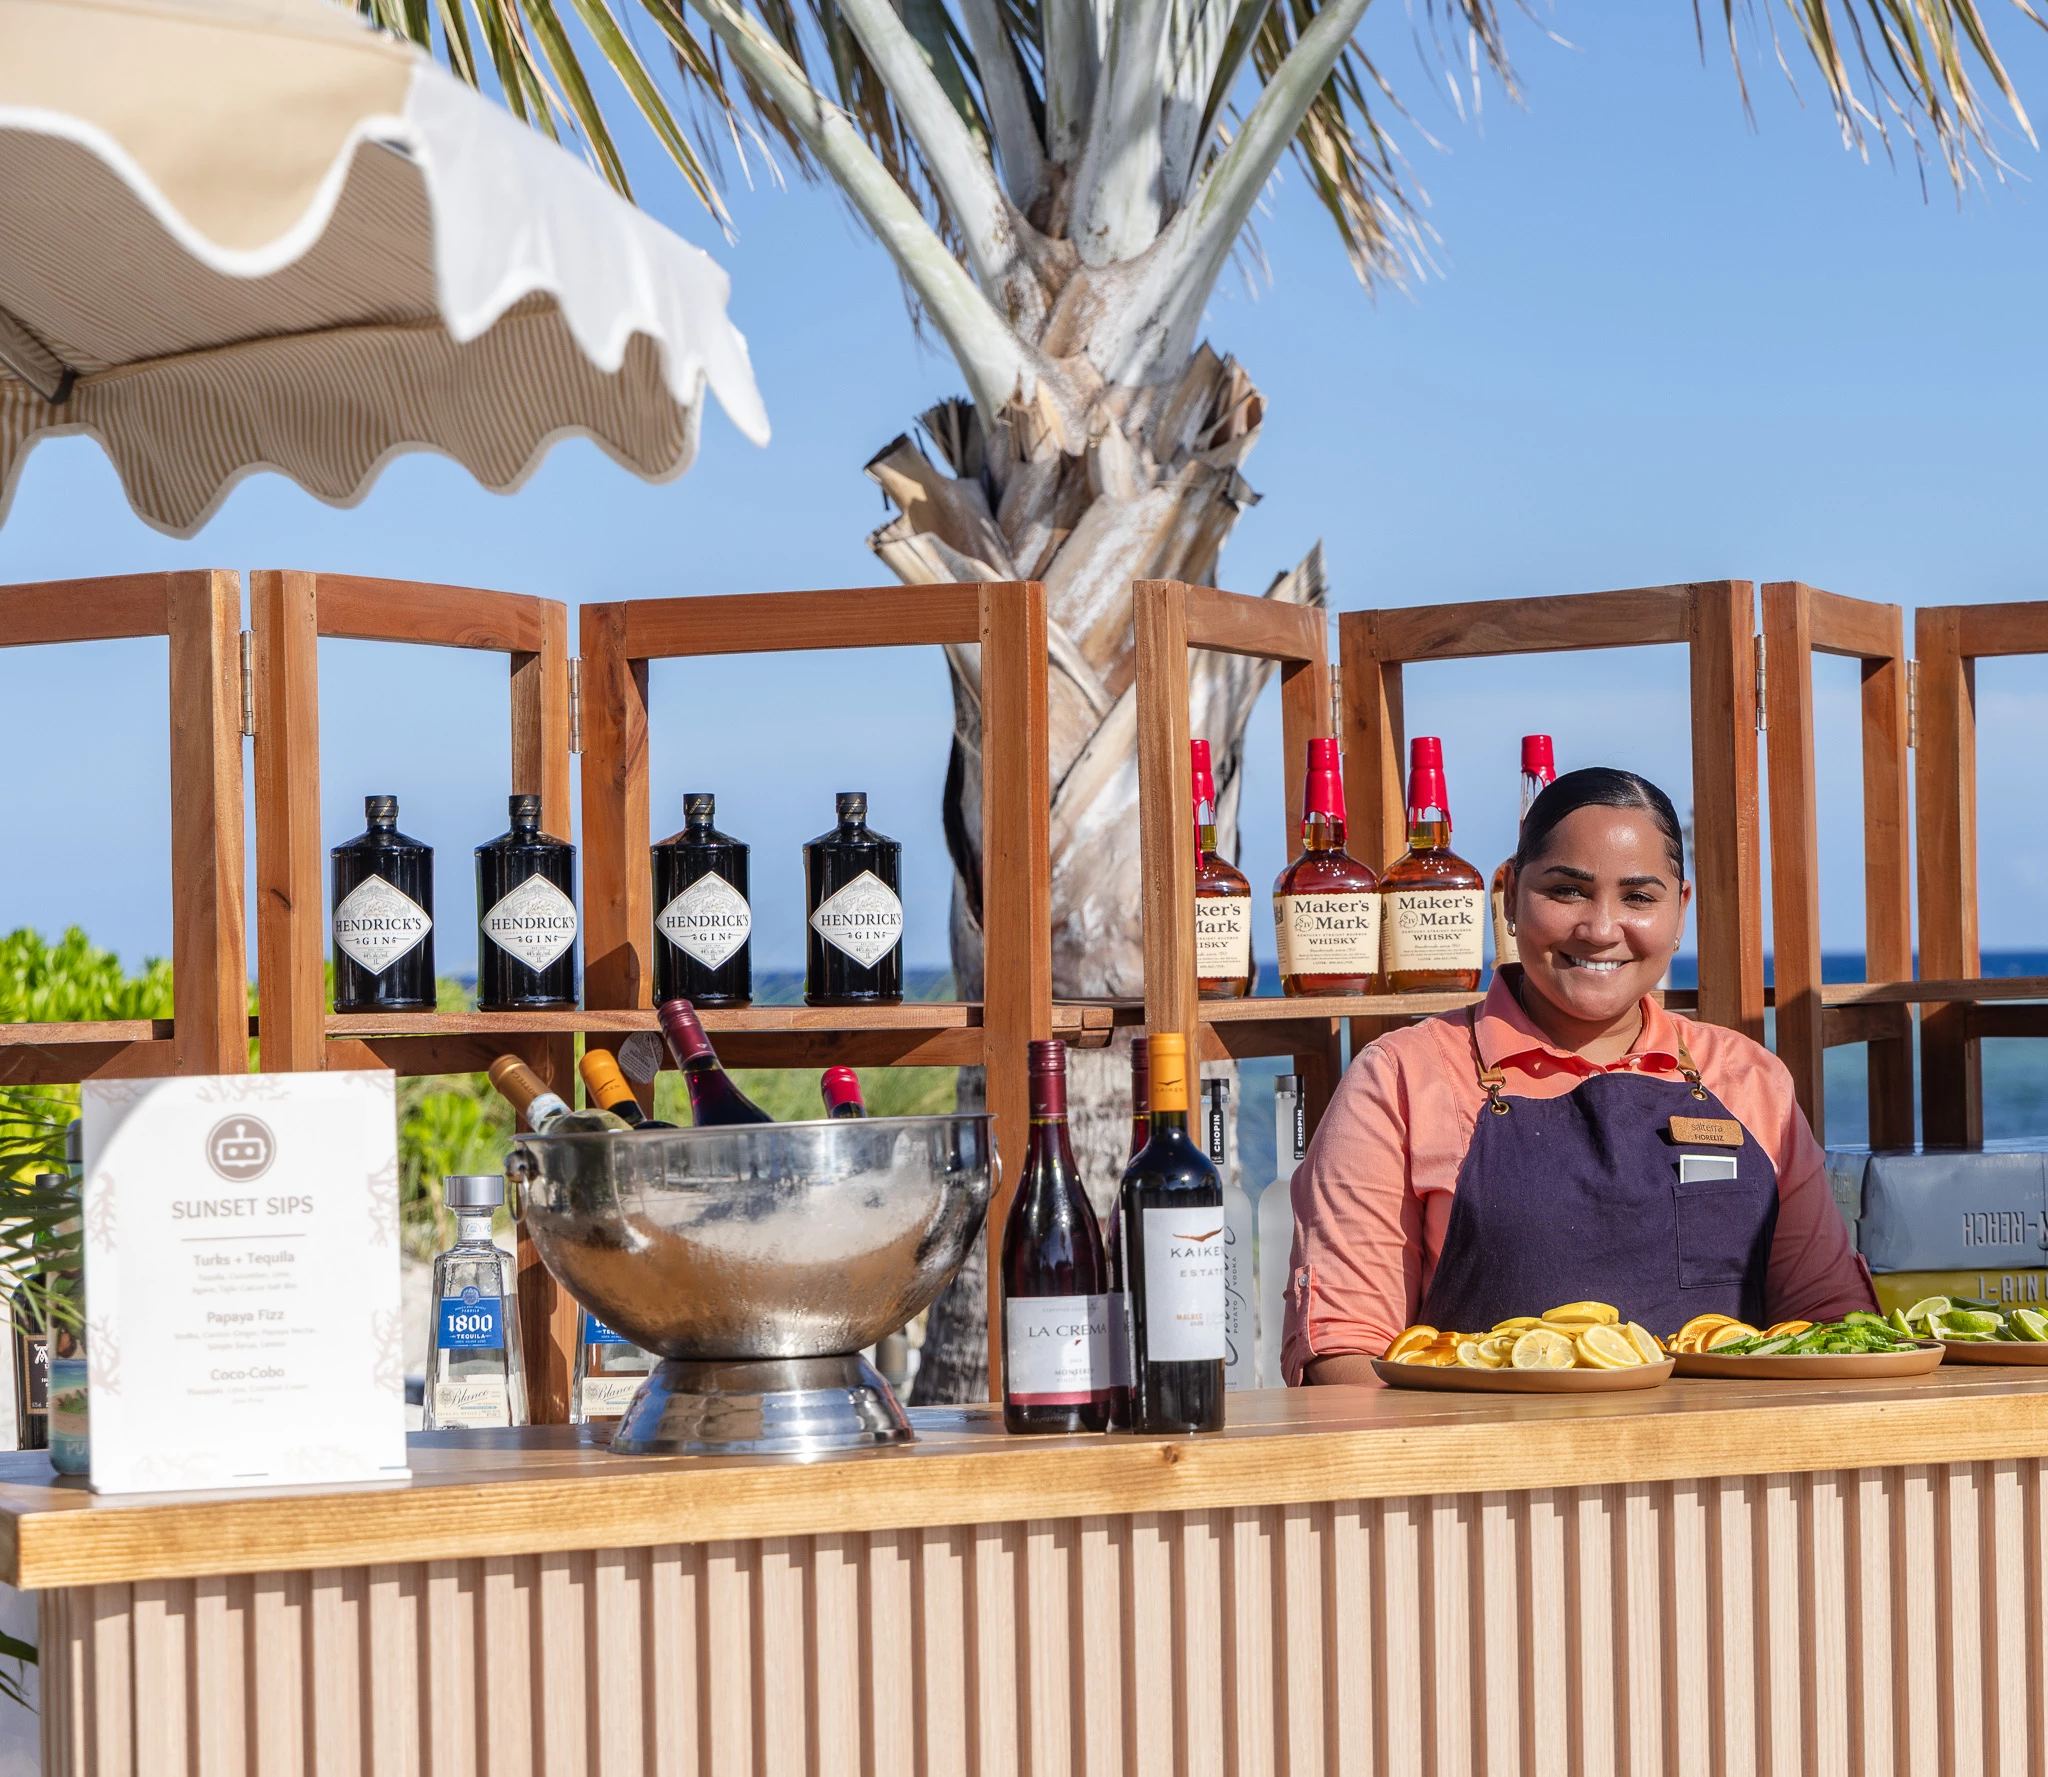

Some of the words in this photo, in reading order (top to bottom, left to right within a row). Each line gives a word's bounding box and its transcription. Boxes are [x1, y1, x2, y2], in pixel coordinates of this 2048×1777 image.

[1195, 903, 1241, 916] ker's
[1294, 900, 1370, 914] Maker's
[1398, 896, 1474, 910] Maker's
[335, 917, 422, 933] HENDRICK'S
[491, 916, 575, 930] HENDRICK'S
[666, 914, 749, 928] HENDRICK'S
[821, 912, 902, 926] HENDRICK'S
[1315, 916, 1369, 930] Mark
[1420, 912, 1473, 925] Mark
[362, 936, 390, 945] GIN
[525, 935, 552, 944] GIN
[700, 932, 726, 941] GIN
[855, 931, 880, 940] GIN
[1309, 937, 1358, 945] WHISKY
[1413, 933, 1462, 941] WHISKY
[1213, 1114, 1221, 1152] CHOPIN
[1691, 1122, 1723, 1132] salterra
[171, 1198, 259, 1220] SUNSET
[266, 1195, 314, 1216] SIPS
[192, 1254, 231, 1267] Turks
[247, 1250, 295, 1267] Tequila
[206, 1311, 254, 1326] Papaya
[258, 1308, 285, 1321] Fizz
[447, 1313, 493, 1333] 1800
[1028, 1326, 1050, 1338] LA
[1056, 1323, 1107, 1337] CREMA
[210, 1365, 285, 1381] Coco-Cobo
[449, 1387, 489, 1406] Blanco
[592, 1383, 634, 1402] Blanco
